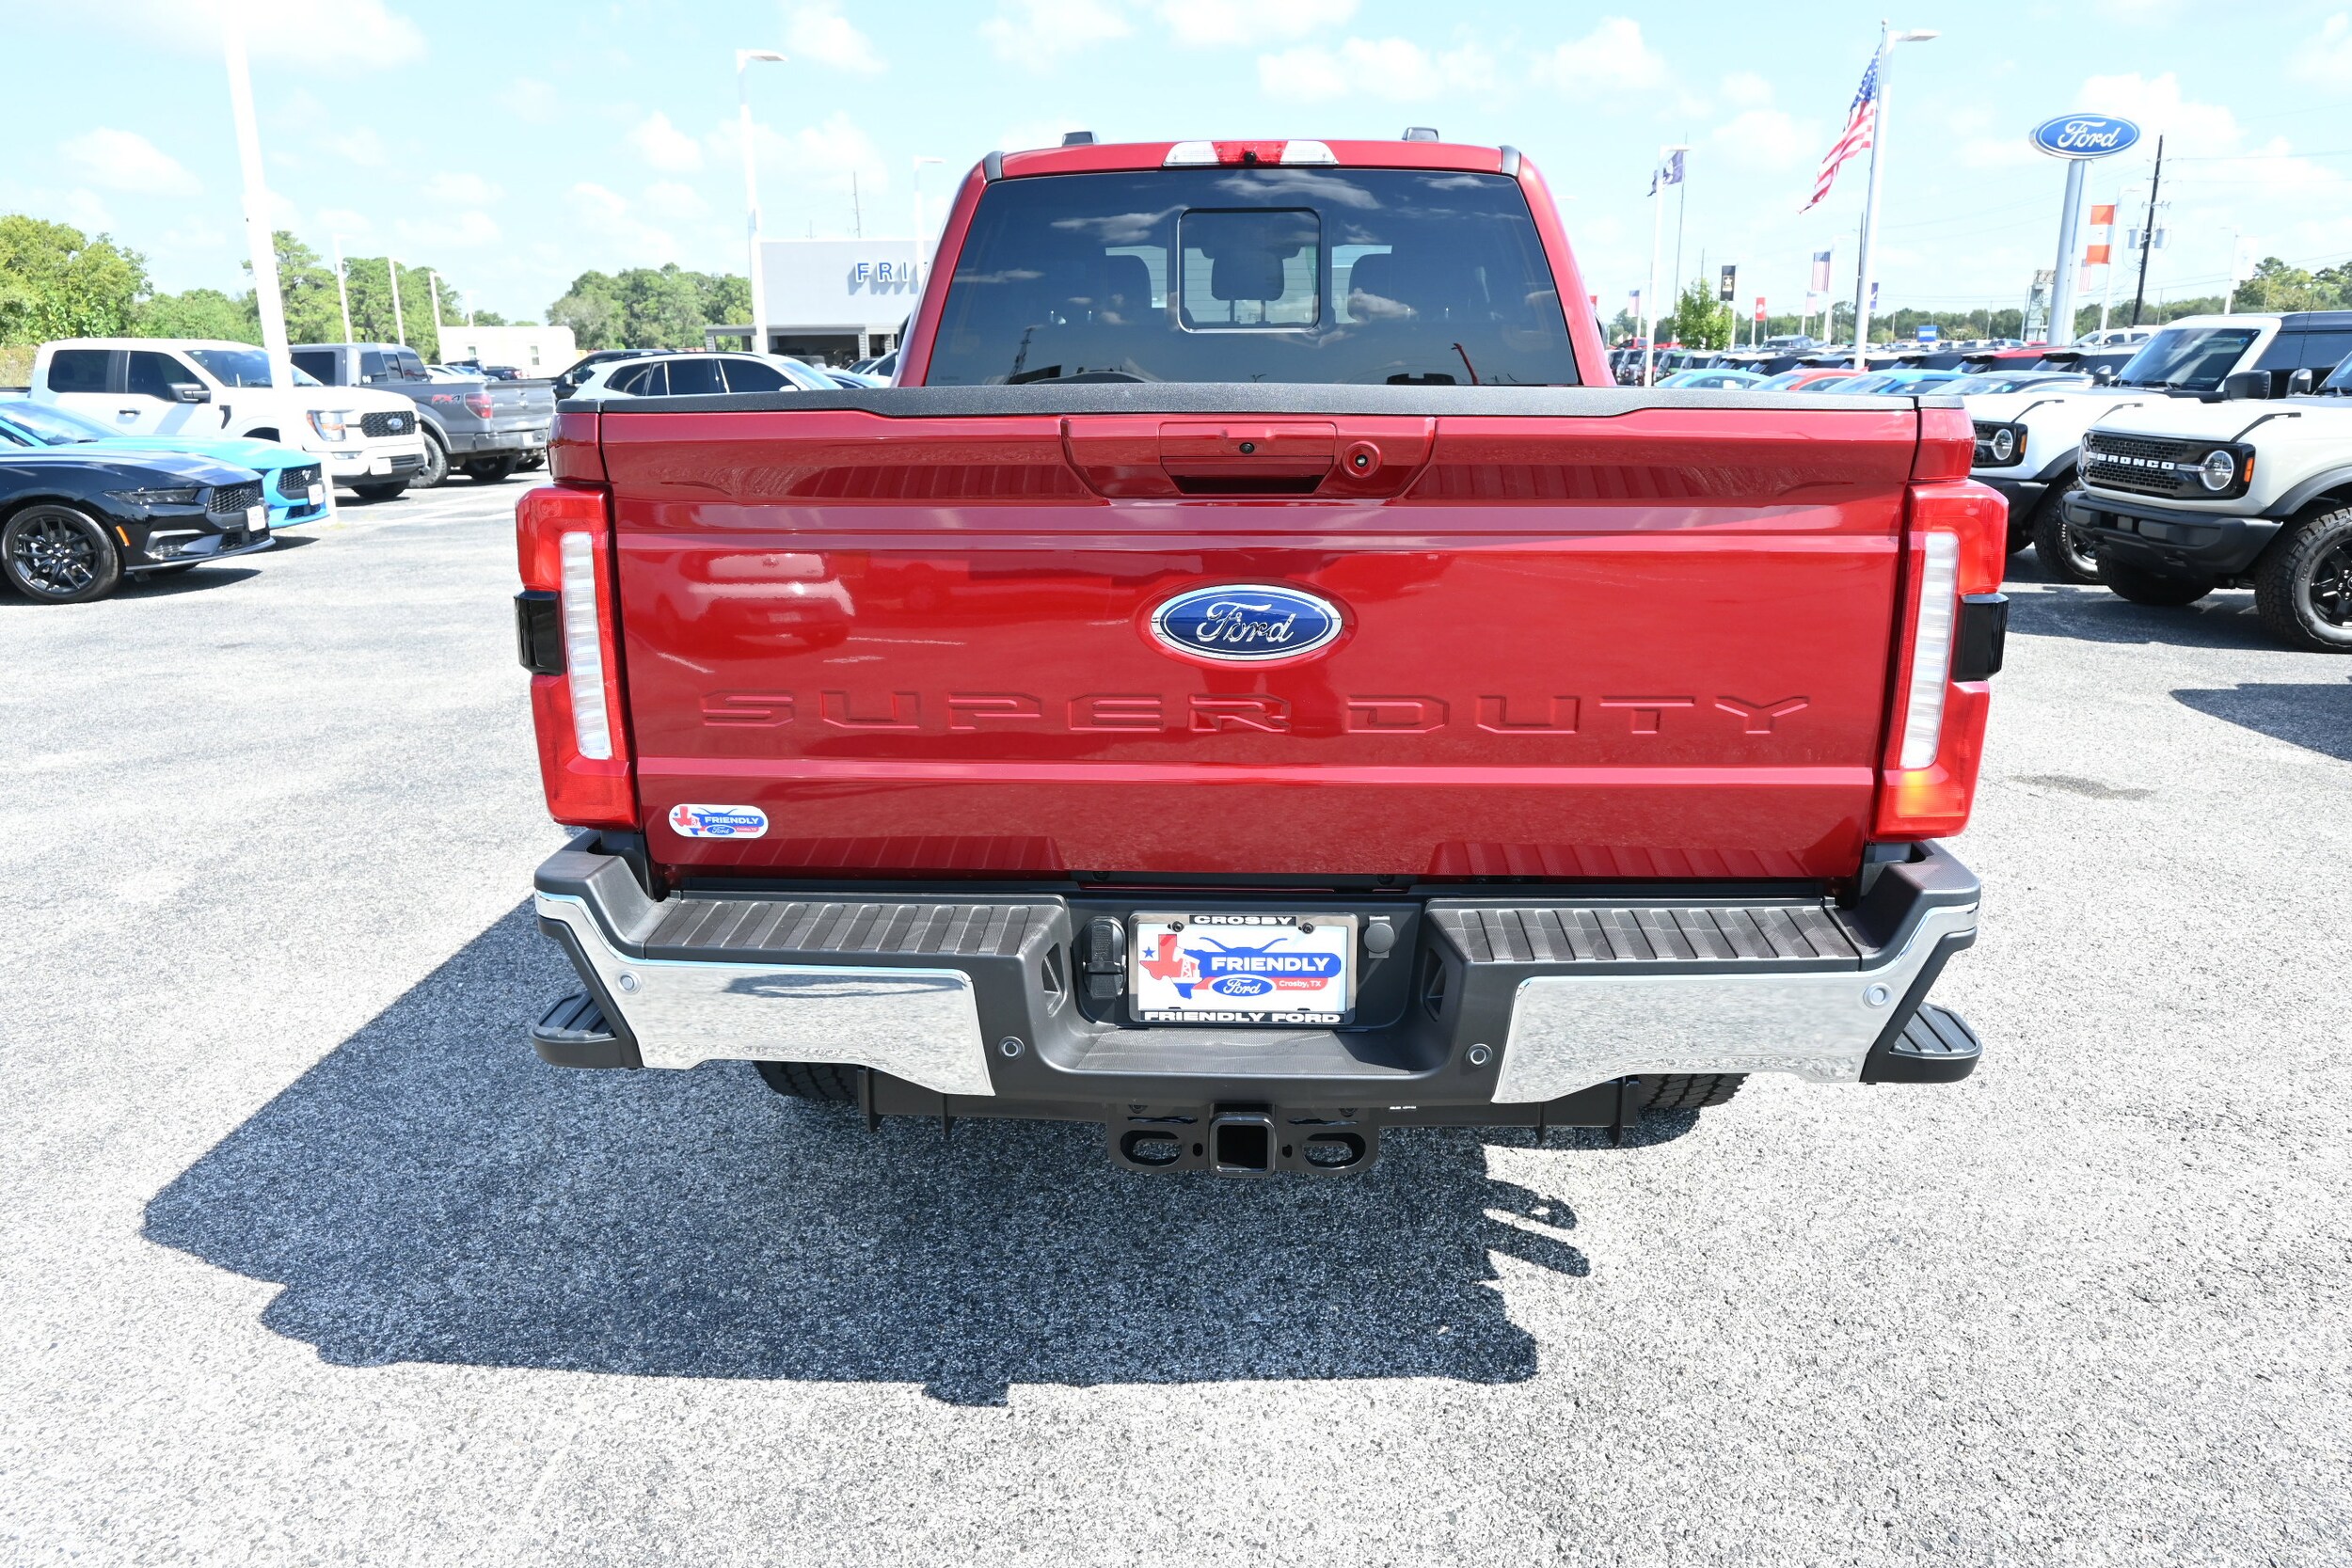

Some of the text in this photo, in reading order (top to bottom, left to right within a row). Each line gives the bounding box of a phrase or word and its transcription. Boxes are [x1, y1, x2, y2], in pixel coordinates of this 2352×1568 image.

[2057, 119, 2122, 148] Ford
[856, 261, 929, 282] FRI
[2097, 452, 2175, 470] BRONCO
[1195, 602, 1297, 649] Ford
[698, 689, 1810, 736] SUPER DUTY
[705, 816, 759, 825] FRIENDLY
[711, 826, 730, 834] Ford
[1193, 915, 1293, 926] CROSBY
[1211, 957, 1330, 972] FRIENDLY
[1223, 978, 1262, 994] Ford
[1279, 980, 1309, 989] Crosby,
[1144, 1011, 1341, 1023] FRIENDLY FORD
